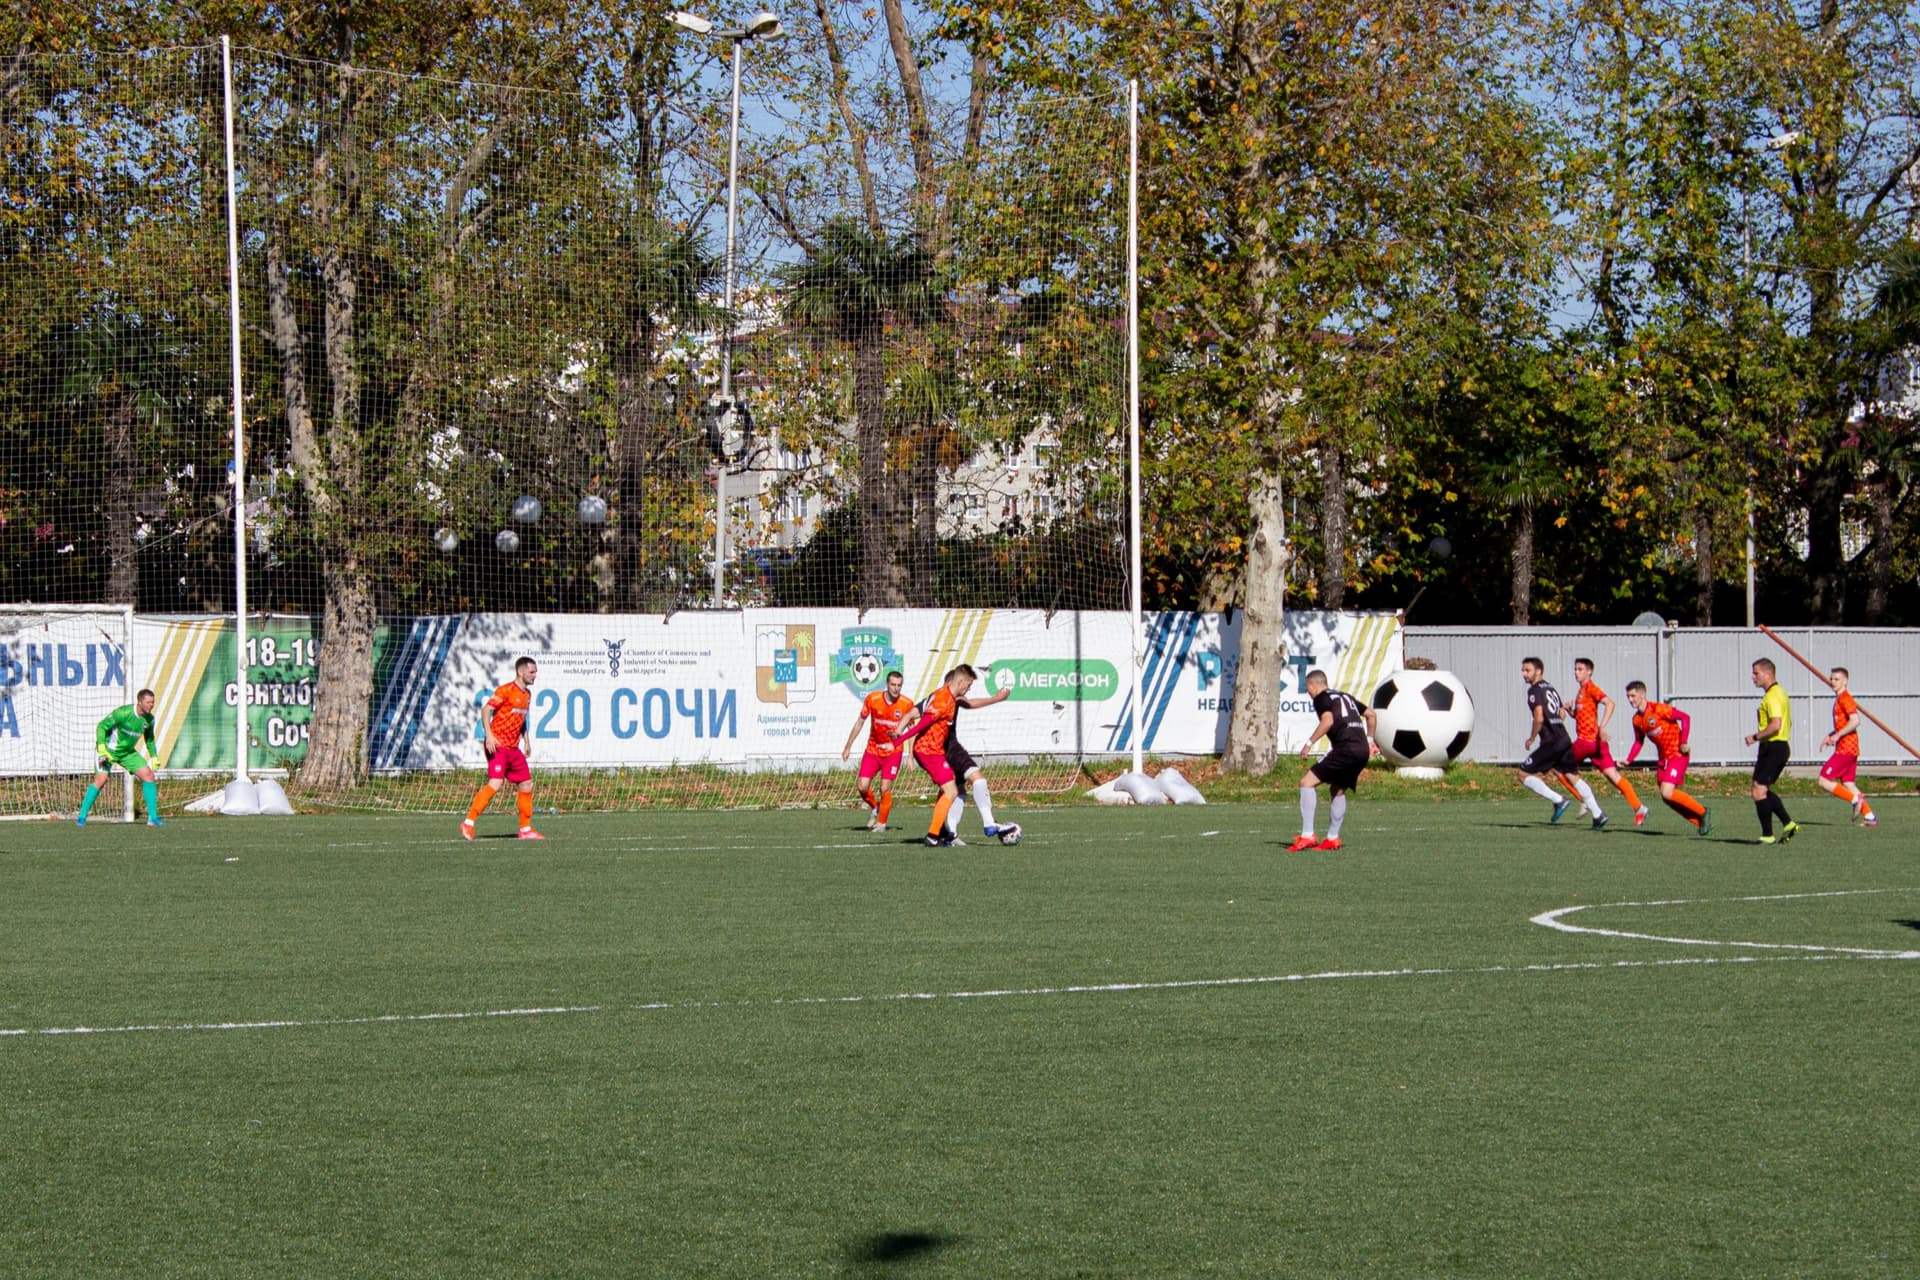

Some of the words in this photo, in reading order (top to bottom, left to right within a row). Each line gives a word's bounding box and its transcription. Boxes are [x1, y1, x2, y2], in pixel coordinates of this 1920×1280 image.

[853, 634, 878, 644] МБУ
[611, 688, 737, 740] СОЧИ
[757, 714, 816, 724] Администрация
[792, 727, 811, 736] Сочи
